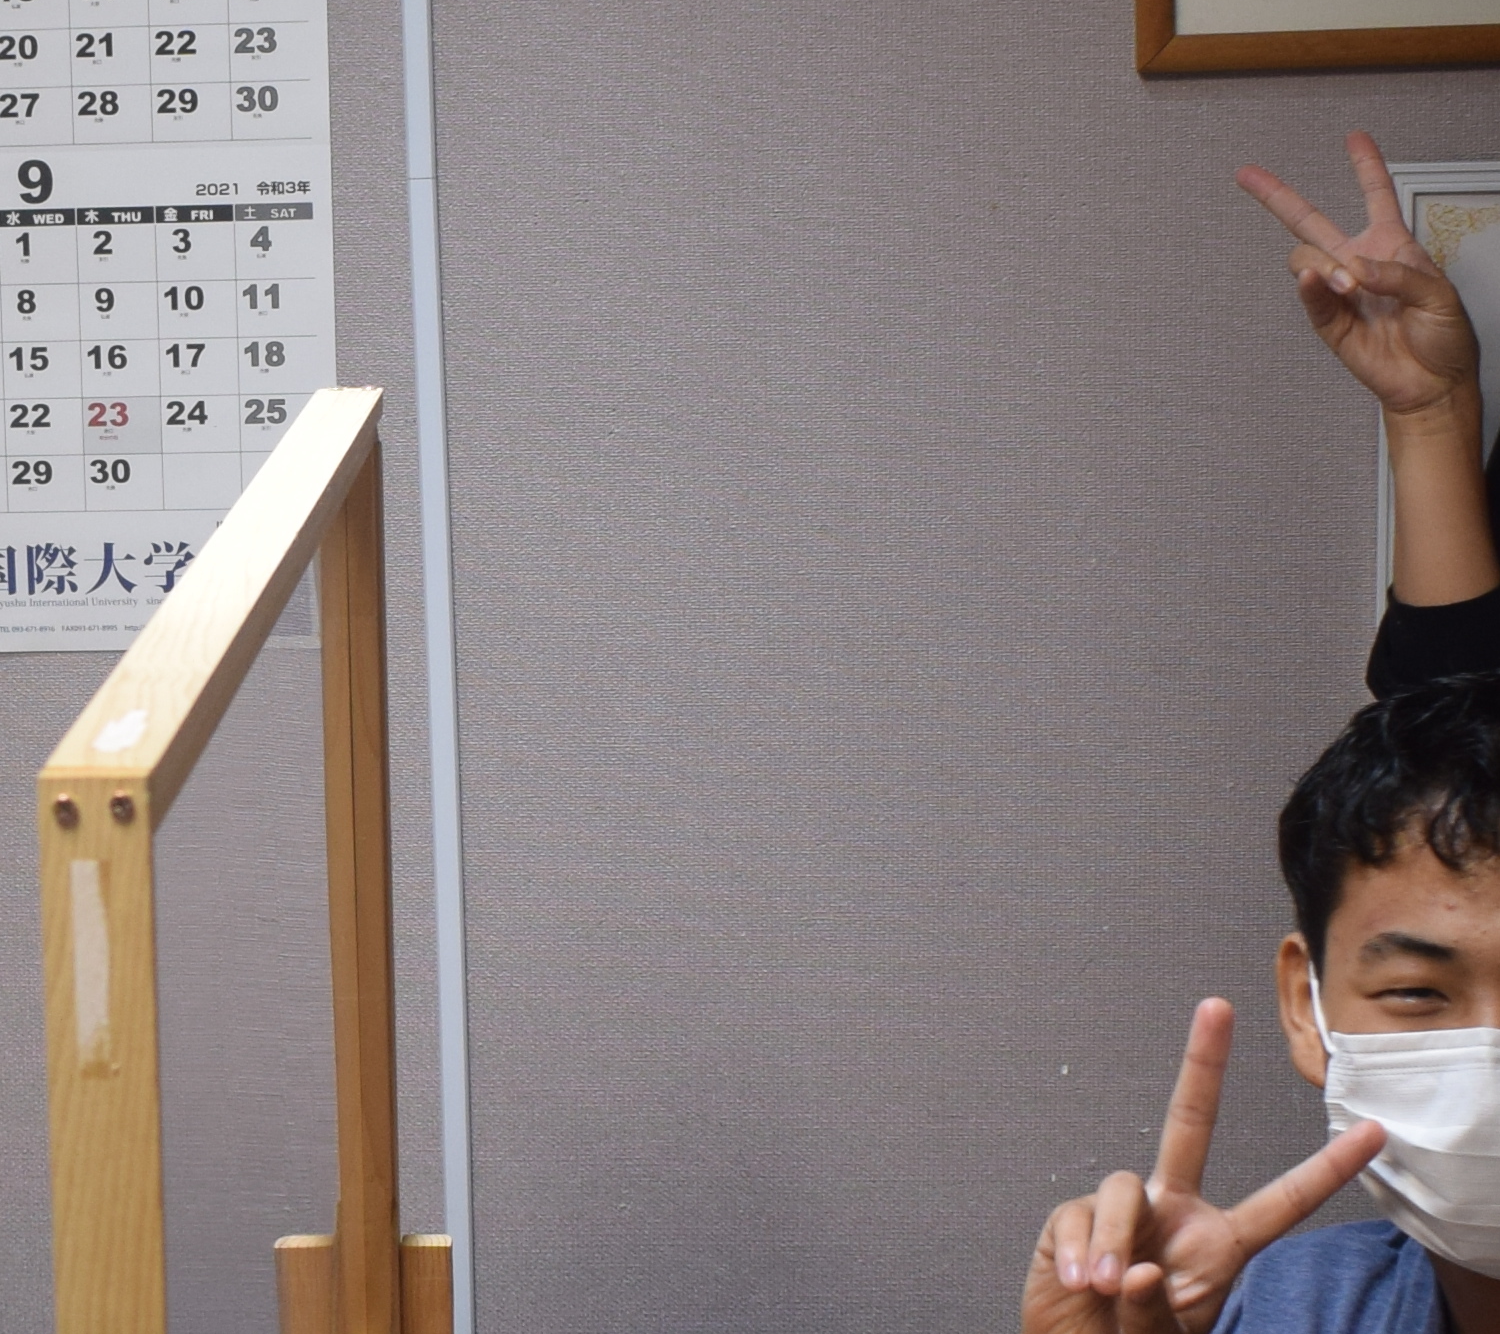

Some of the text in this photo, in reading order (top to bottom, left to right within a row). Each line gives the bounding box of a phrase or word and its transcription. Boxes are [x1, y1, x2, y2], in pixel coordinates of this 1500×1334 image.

[18, 159, 53, 204] 9
[196, 183, 239, 196] 2021
[256, 180, 311, 195] 令和3年
[16, 226, 272, 256] 1 2 3 4
[18, 290, 36, 313] 8
[95, 288, 114, 312] 9
[164, 286, 203, 310] 10
[243, 284, 279, 309] 11
[10, 347, 48, 371] 15
[88, 345, 127, 369] 16
[166, 344, 205, 367] 17
[245, 341, 285, 366] 18
[12, 461, 52, 484] 29
[91, 459, 130, 483] 30
[29, 597, 89, 607] International
[91, 597, 138, 608] University
